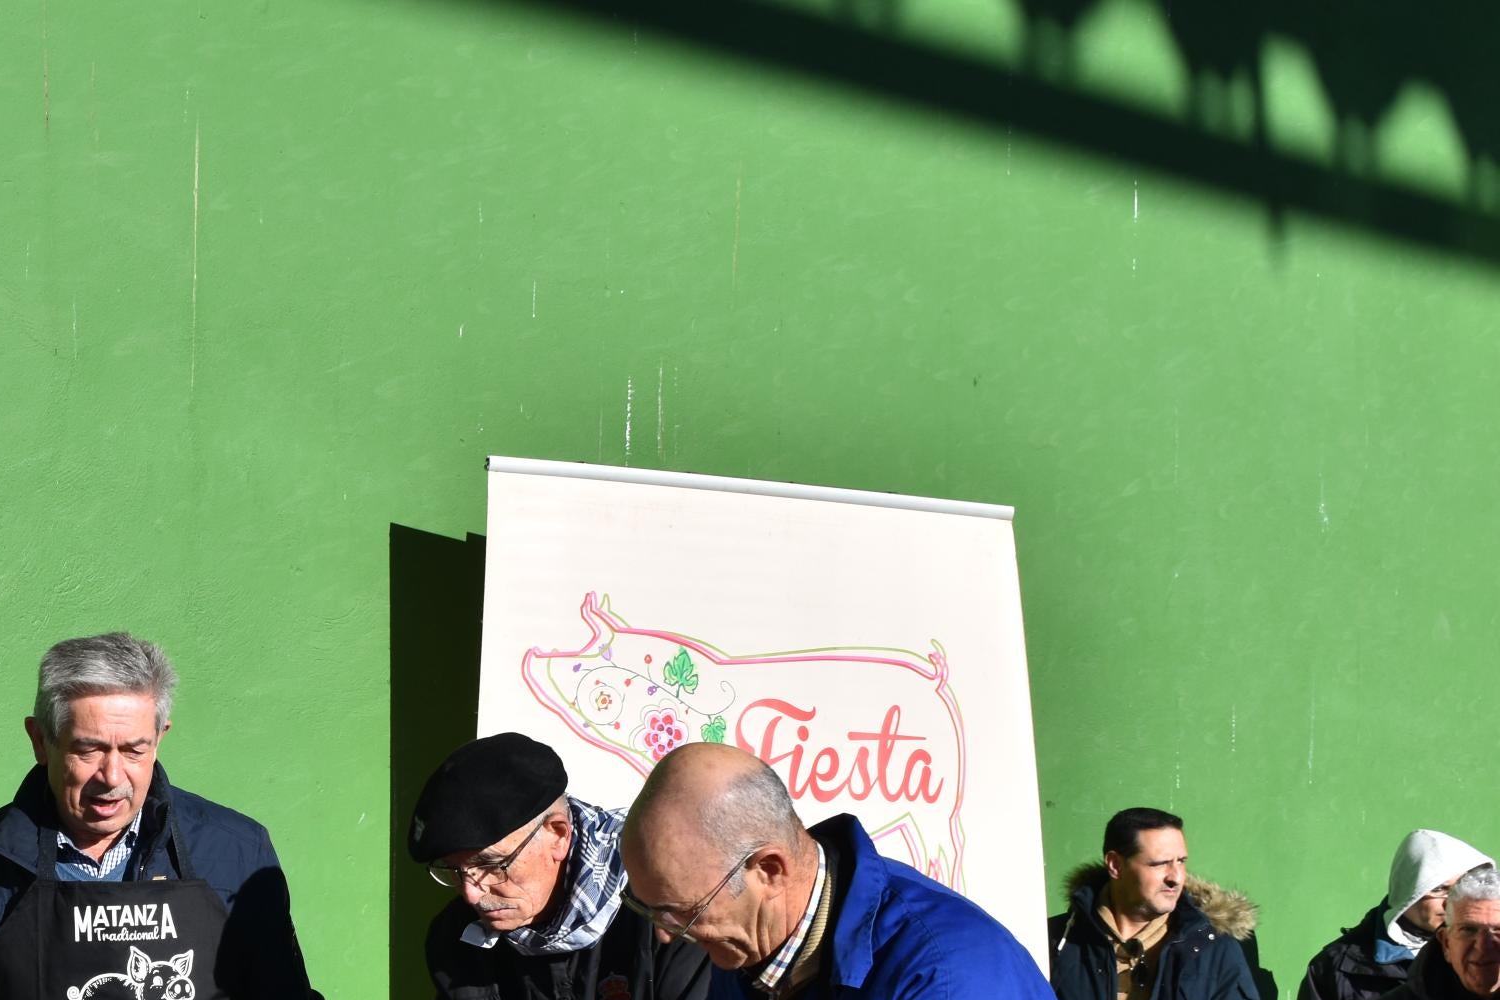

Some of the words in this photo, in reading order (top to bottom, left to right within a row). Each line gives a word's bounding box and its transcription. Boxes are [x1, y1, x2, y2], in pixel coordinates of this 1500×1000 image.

[735, 698, 944, 804] Fiesta
[74, 903, 178, 942] MATANZA
[93, 926, 160, 942] Tradicional
